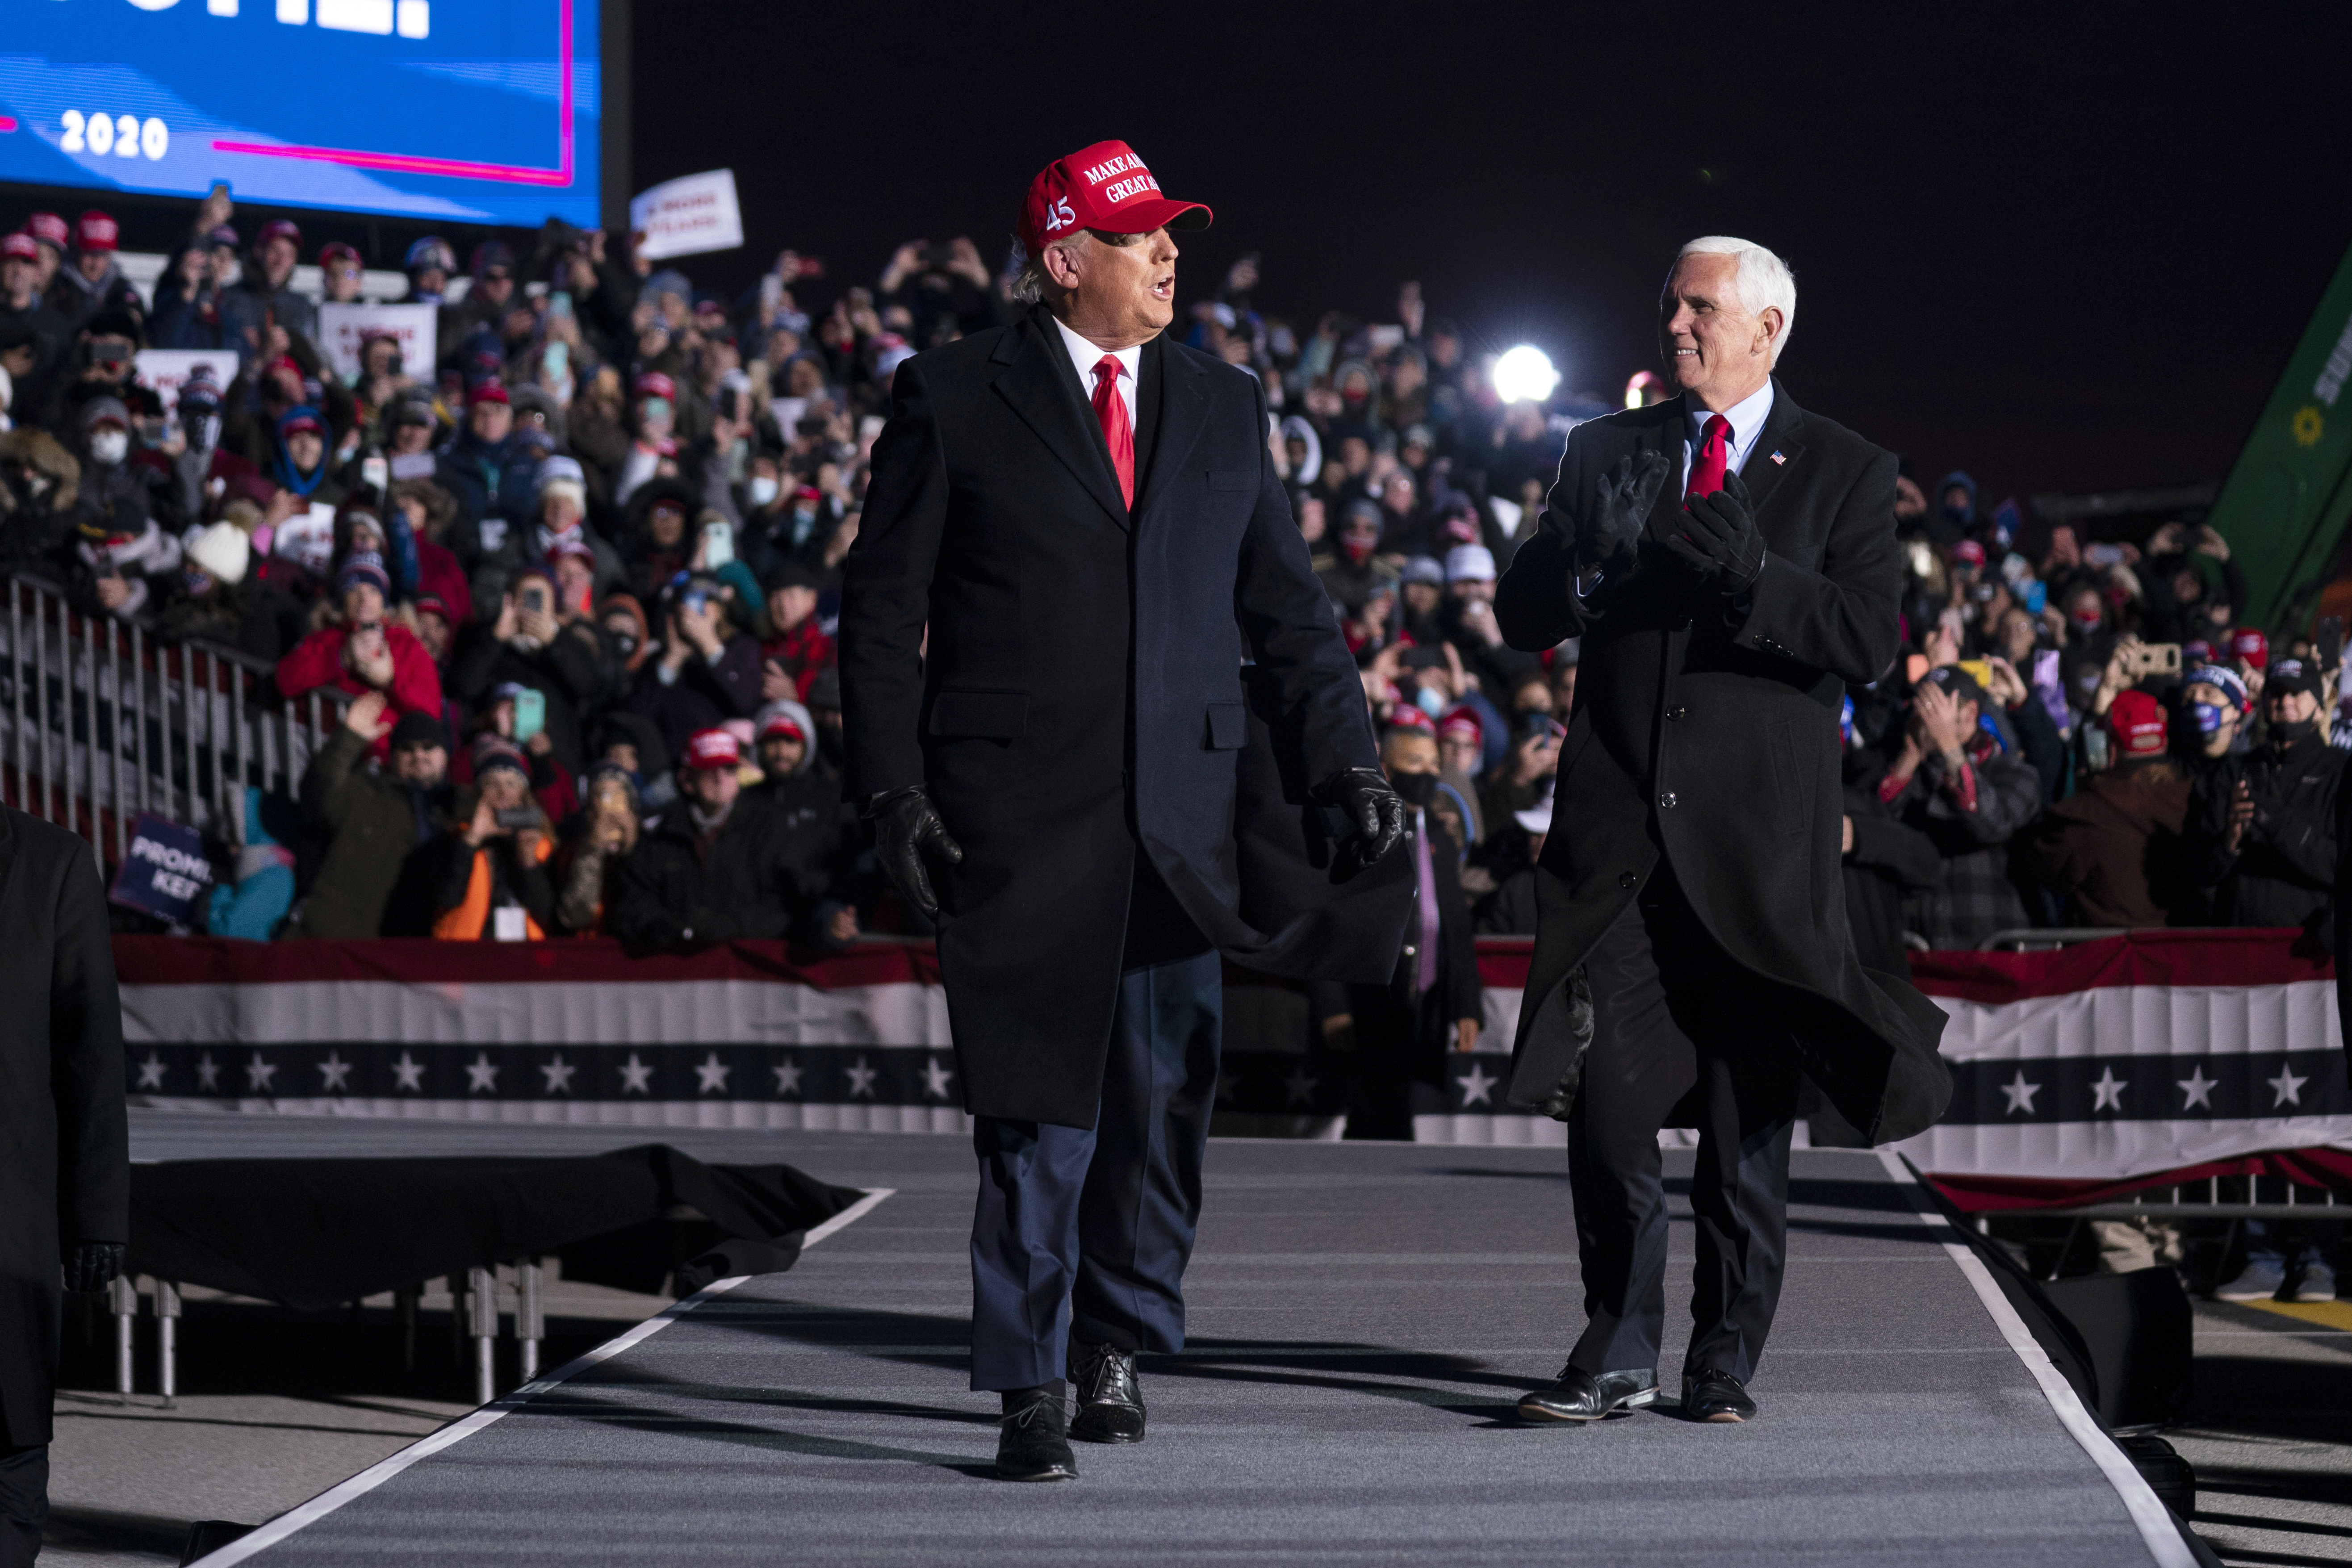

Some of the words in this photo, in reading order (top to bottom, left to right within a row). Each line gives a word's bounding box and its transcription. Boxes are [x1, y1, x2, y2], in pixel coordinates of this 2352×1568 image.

[59, 108, 169, 161] 2020
[1083, 156, 1129, 185] MAKE
[1106, 175, 1150, 203] GREAT
[1046, 196, 1076, 231] 45
